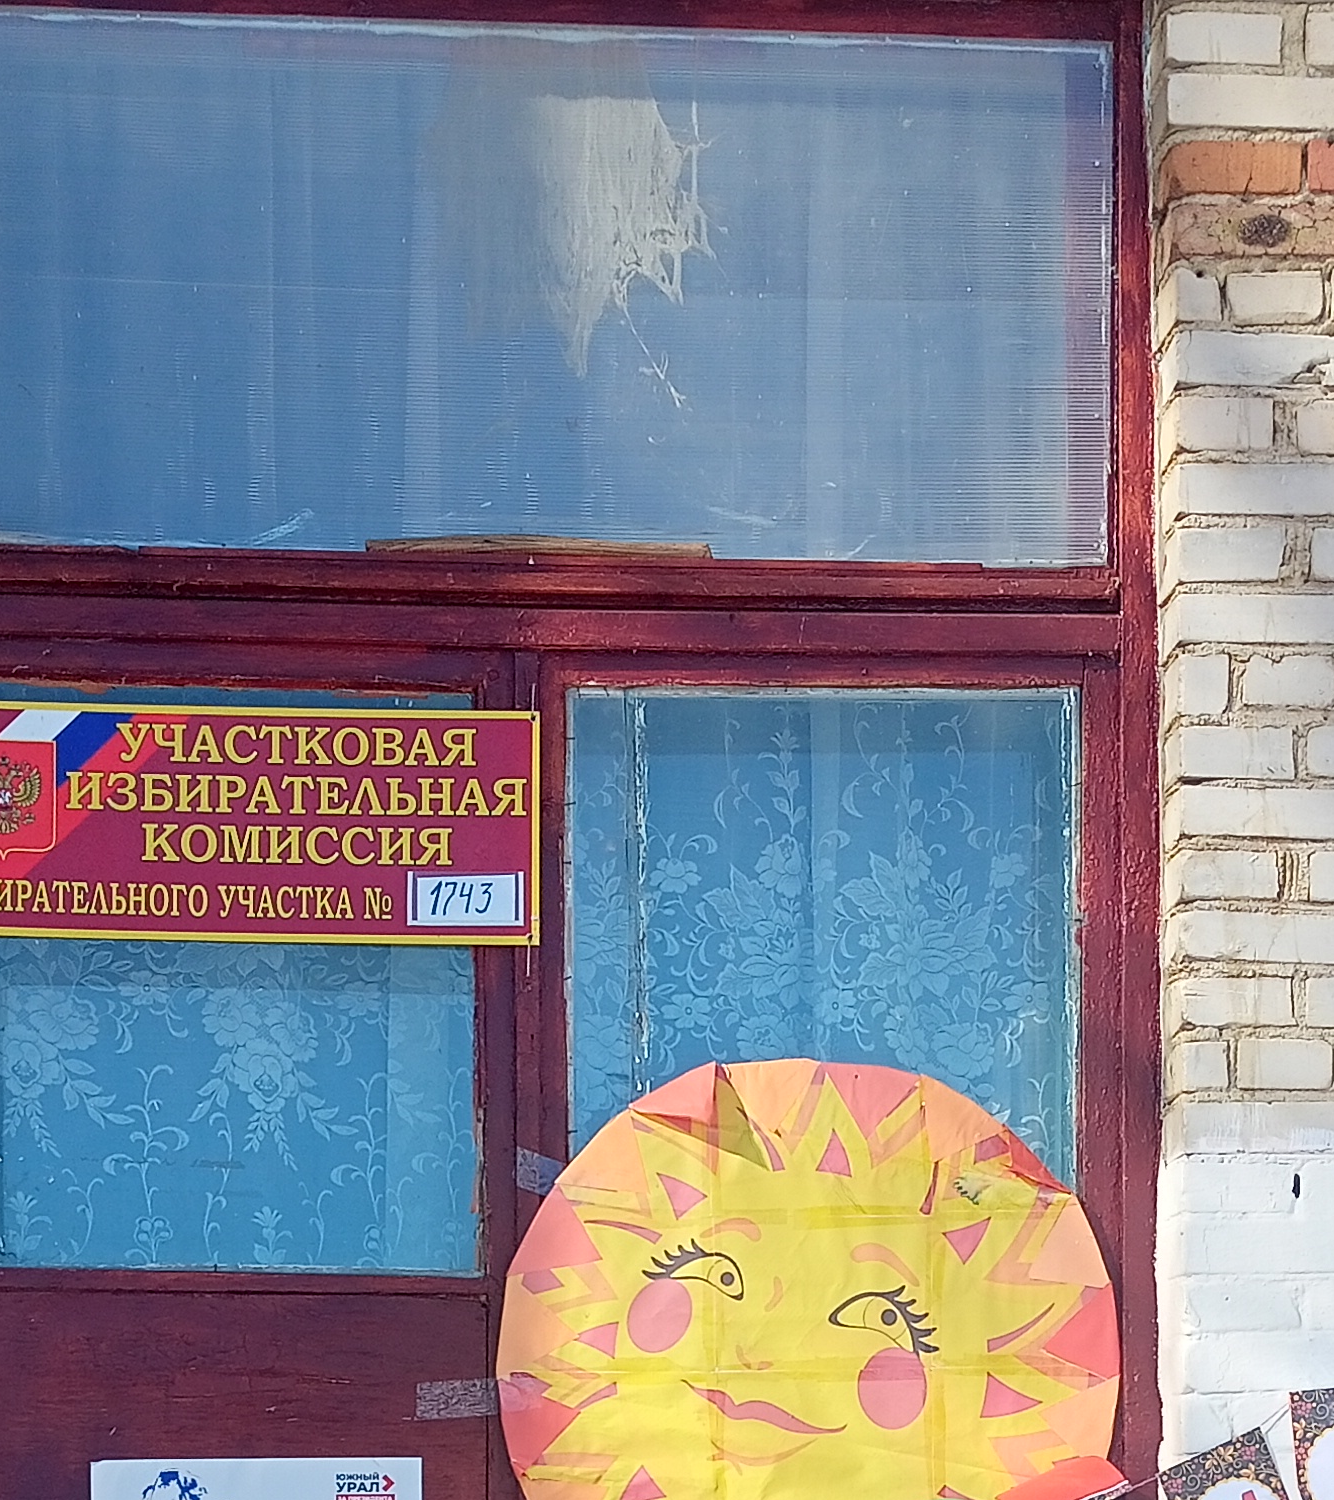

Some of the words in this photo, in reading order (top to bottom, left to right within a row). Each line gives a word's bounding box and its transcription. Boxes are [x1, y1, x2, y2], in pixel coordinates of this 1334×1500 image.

[115, 722, 479, 768] УЧАСТКОВАЯ
[66, 770, 528, 818] ИЗБИРАТЕЛЬНАЯ
[140, 822, 454, 867] КОМИССИЯ
[217, 884, 355, 920] УЧАСТКА
[363, 886, 393, 919] №
[429, 879, 495, 916] 1743
[336, 1471, 380, 1481] ЮЖНЫЙ
[336, 1481, 380, 1493] УРАЛ
